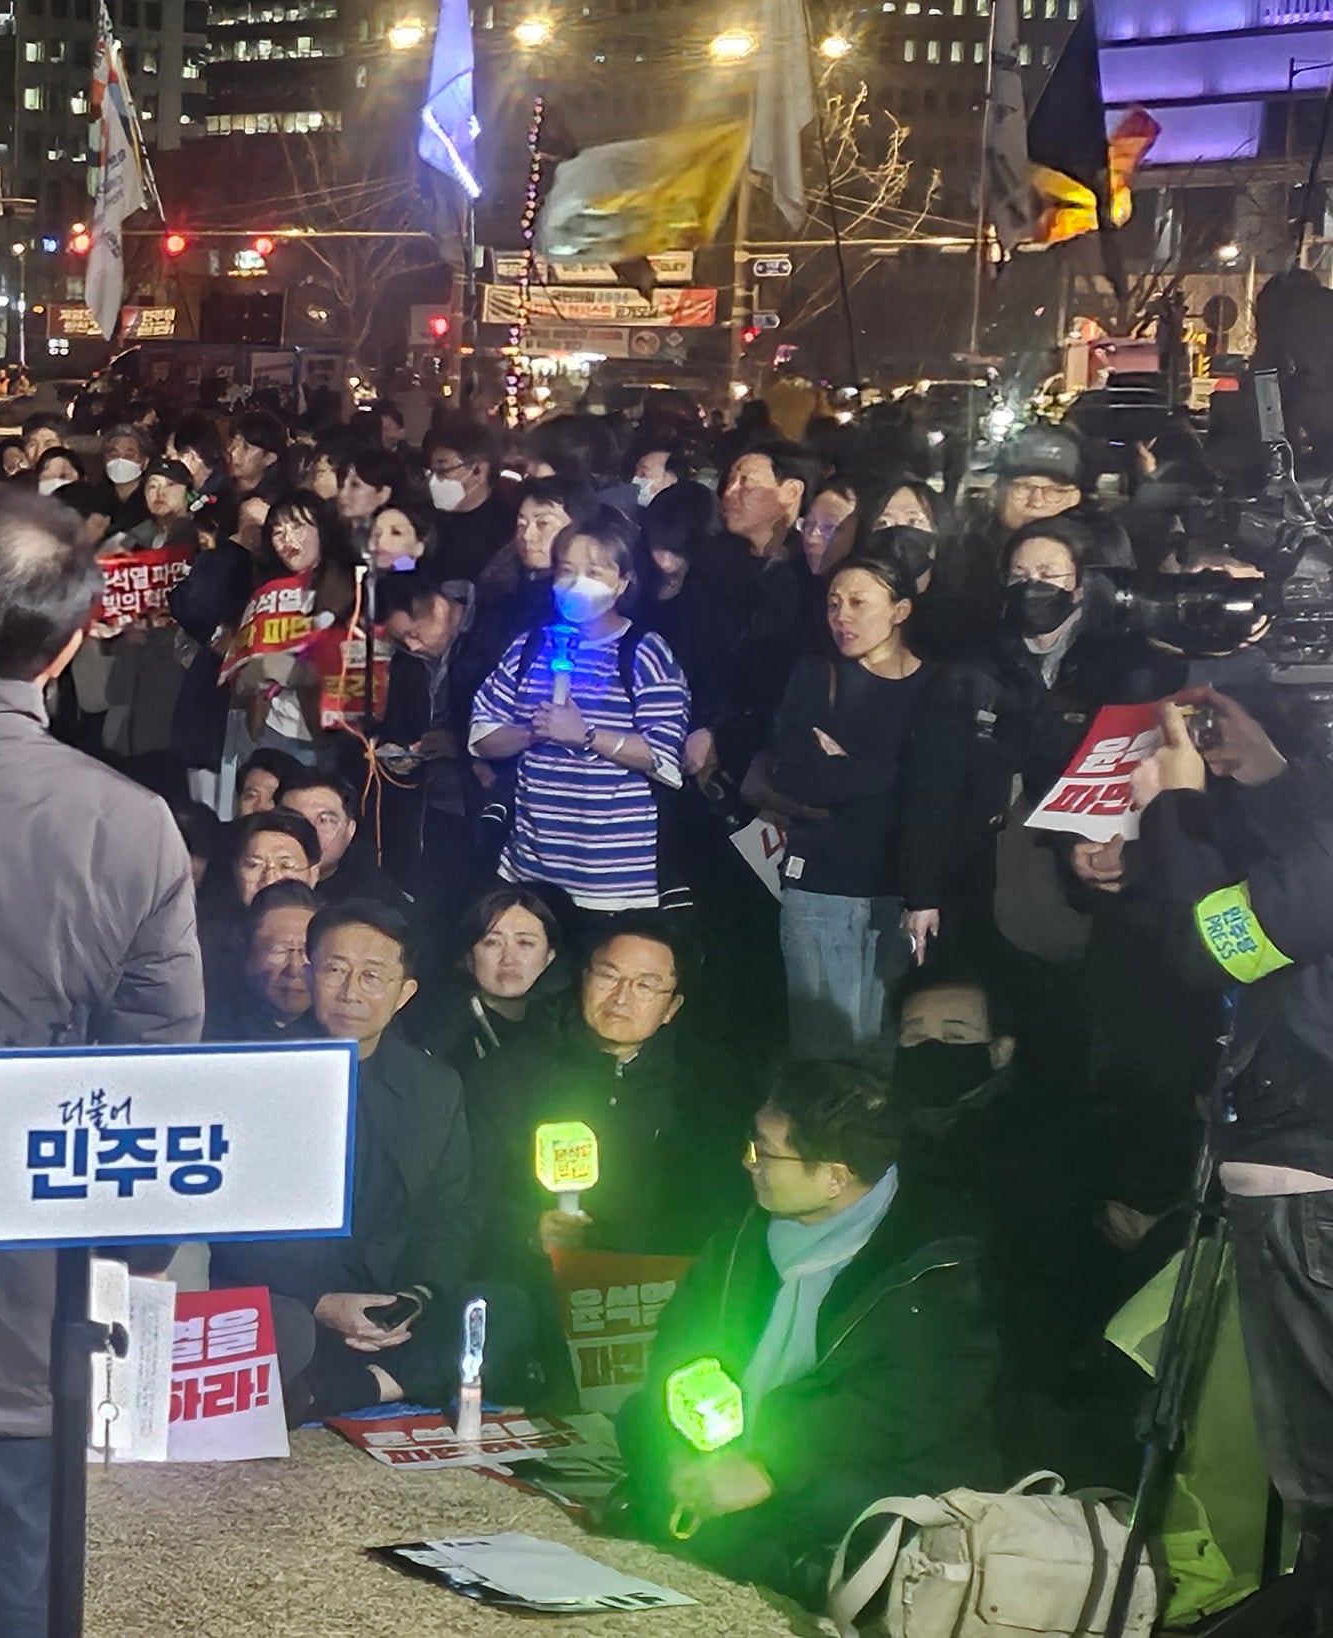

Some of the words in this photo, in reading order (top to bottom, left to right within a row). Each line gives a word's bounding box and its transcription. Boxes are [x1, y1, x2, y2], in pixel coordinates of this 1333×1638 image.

[102, 591, 141, 616] 빛의
[1204, 914, 1239, 960] PRESS
[58, 1088, 133, 1132] 더불어
[27, 1124, 229, 1200] 민주당
